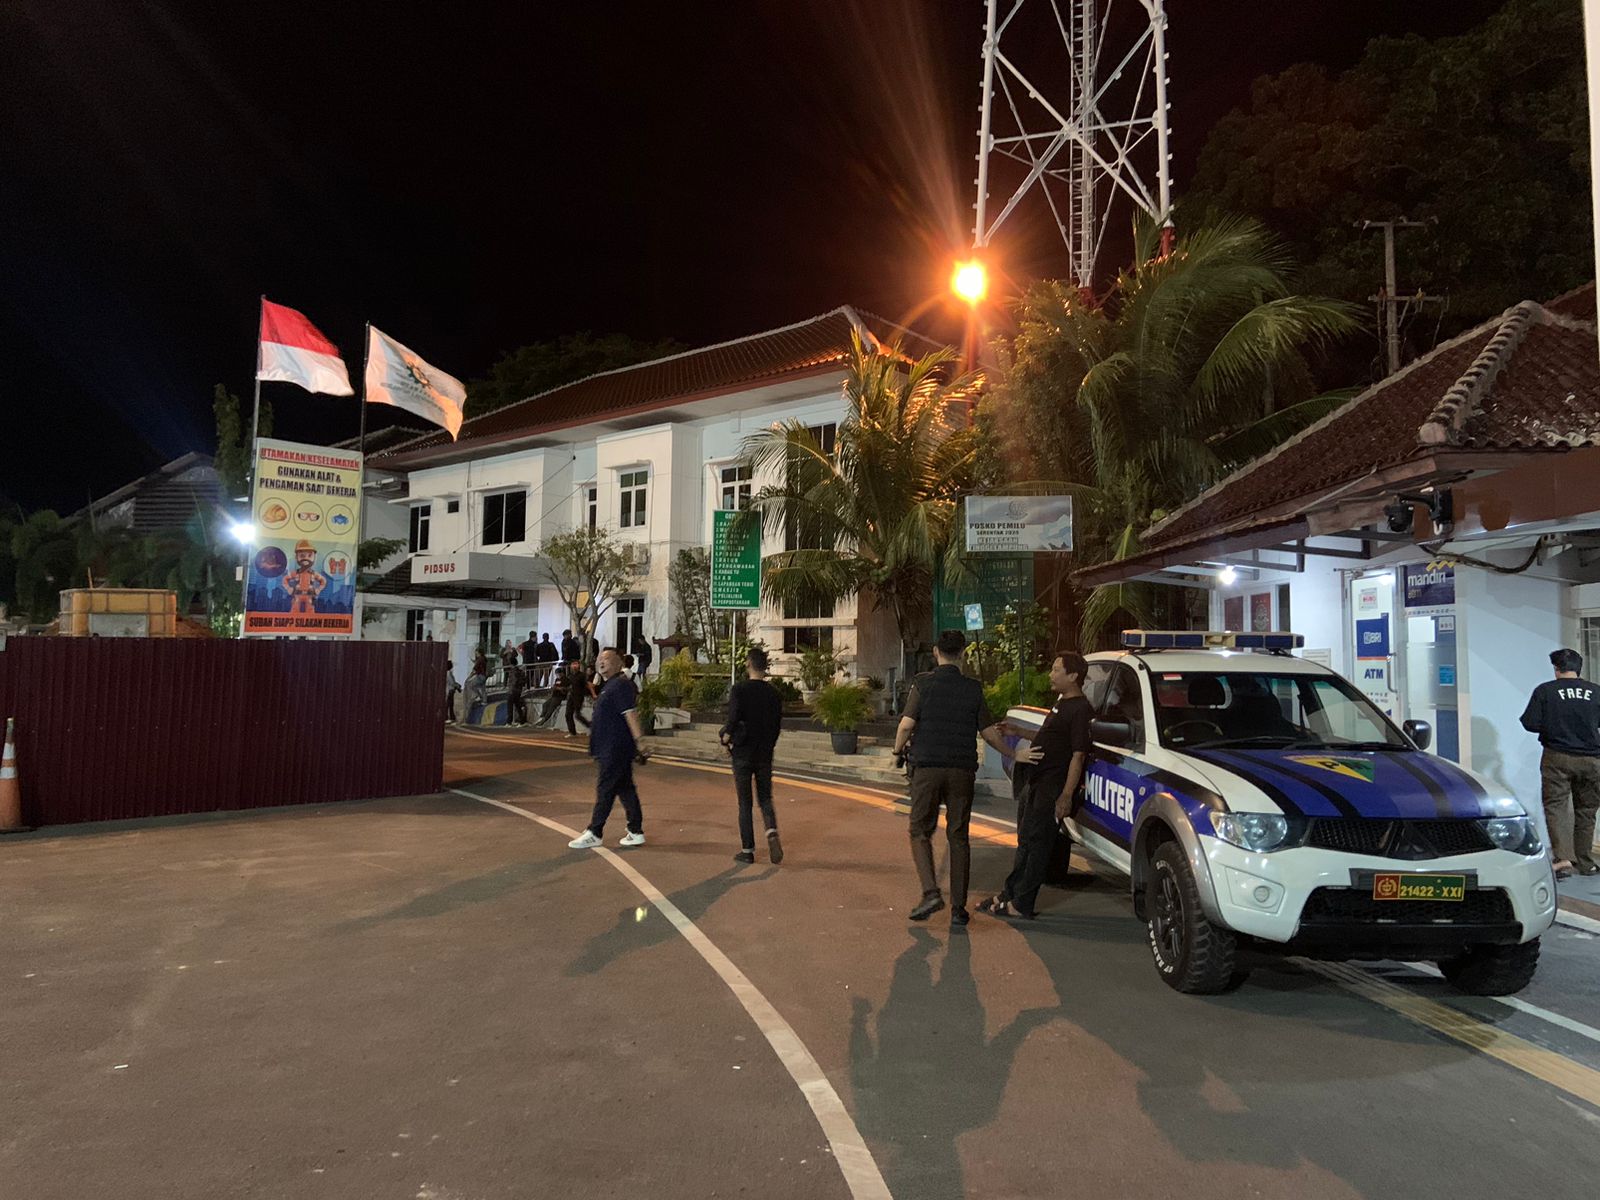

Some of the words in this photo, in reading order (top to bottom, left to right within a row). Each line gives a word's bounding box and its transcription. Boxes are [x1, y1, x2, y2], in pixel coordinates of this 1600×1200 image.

[261, 448, 305, 463] UTAMAKAN
[305, 453, 360, 469] KESELAMATAN
[277, 466, 316, 480] GUNAKAN
[317, 471, 335, 482] ALAT
[336, 475, 342, 483] &
[260, 478, 304, 492] PENGAMAN
[306, 483, 324, 495] SAAT
[326, 486, 357, 498] BEKERJA
[423, 562, 456, 574] PIDSUS
[249, 617, 273, 627] SUDAH
[295, 618, 322, 628] SILAKAN
[1364, 669, 1384, 680] ATM
[1558, 687, 1593, 700] FREE
[1085, 771, 1134, 825] MILITER
[1400, 886, 1434, 897] 21422
[1441, 886, 1462, 898] XXI
